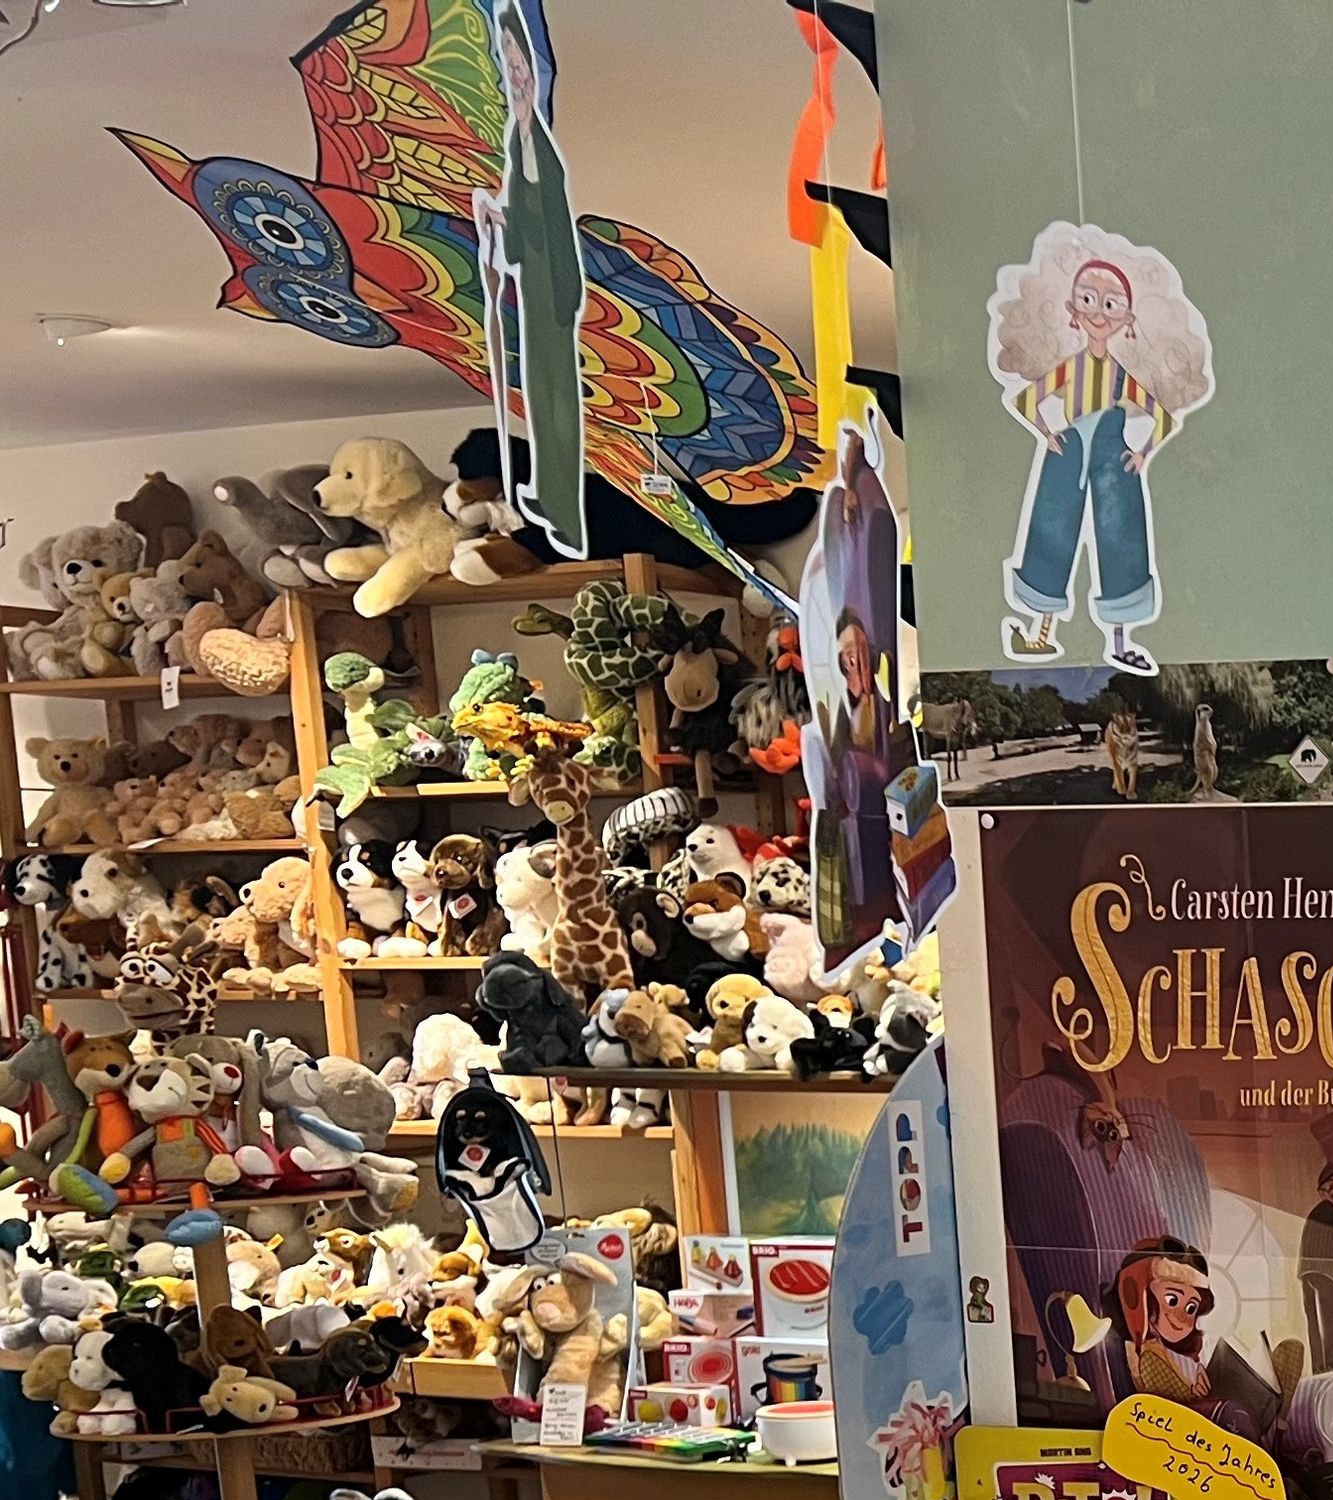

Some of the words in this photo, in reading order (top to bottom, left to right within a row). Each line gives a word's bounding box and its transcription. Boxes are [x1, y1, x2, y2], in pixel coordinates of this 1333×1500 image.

[1171, 878, 1275, 921] Carsten
[1239, 1081, 1276, 1108] und
[1280, 1081, 1314, 1107] der
[895, 1111, 928, 1244] TOPP
[1129, 1401, 1173, 1433] Spiel
[1185, 1430, 1212, 1453] des
[1218, 1442, 1276, 1490] Jahres
[1162, 1455, 1214, 1495] 2026
